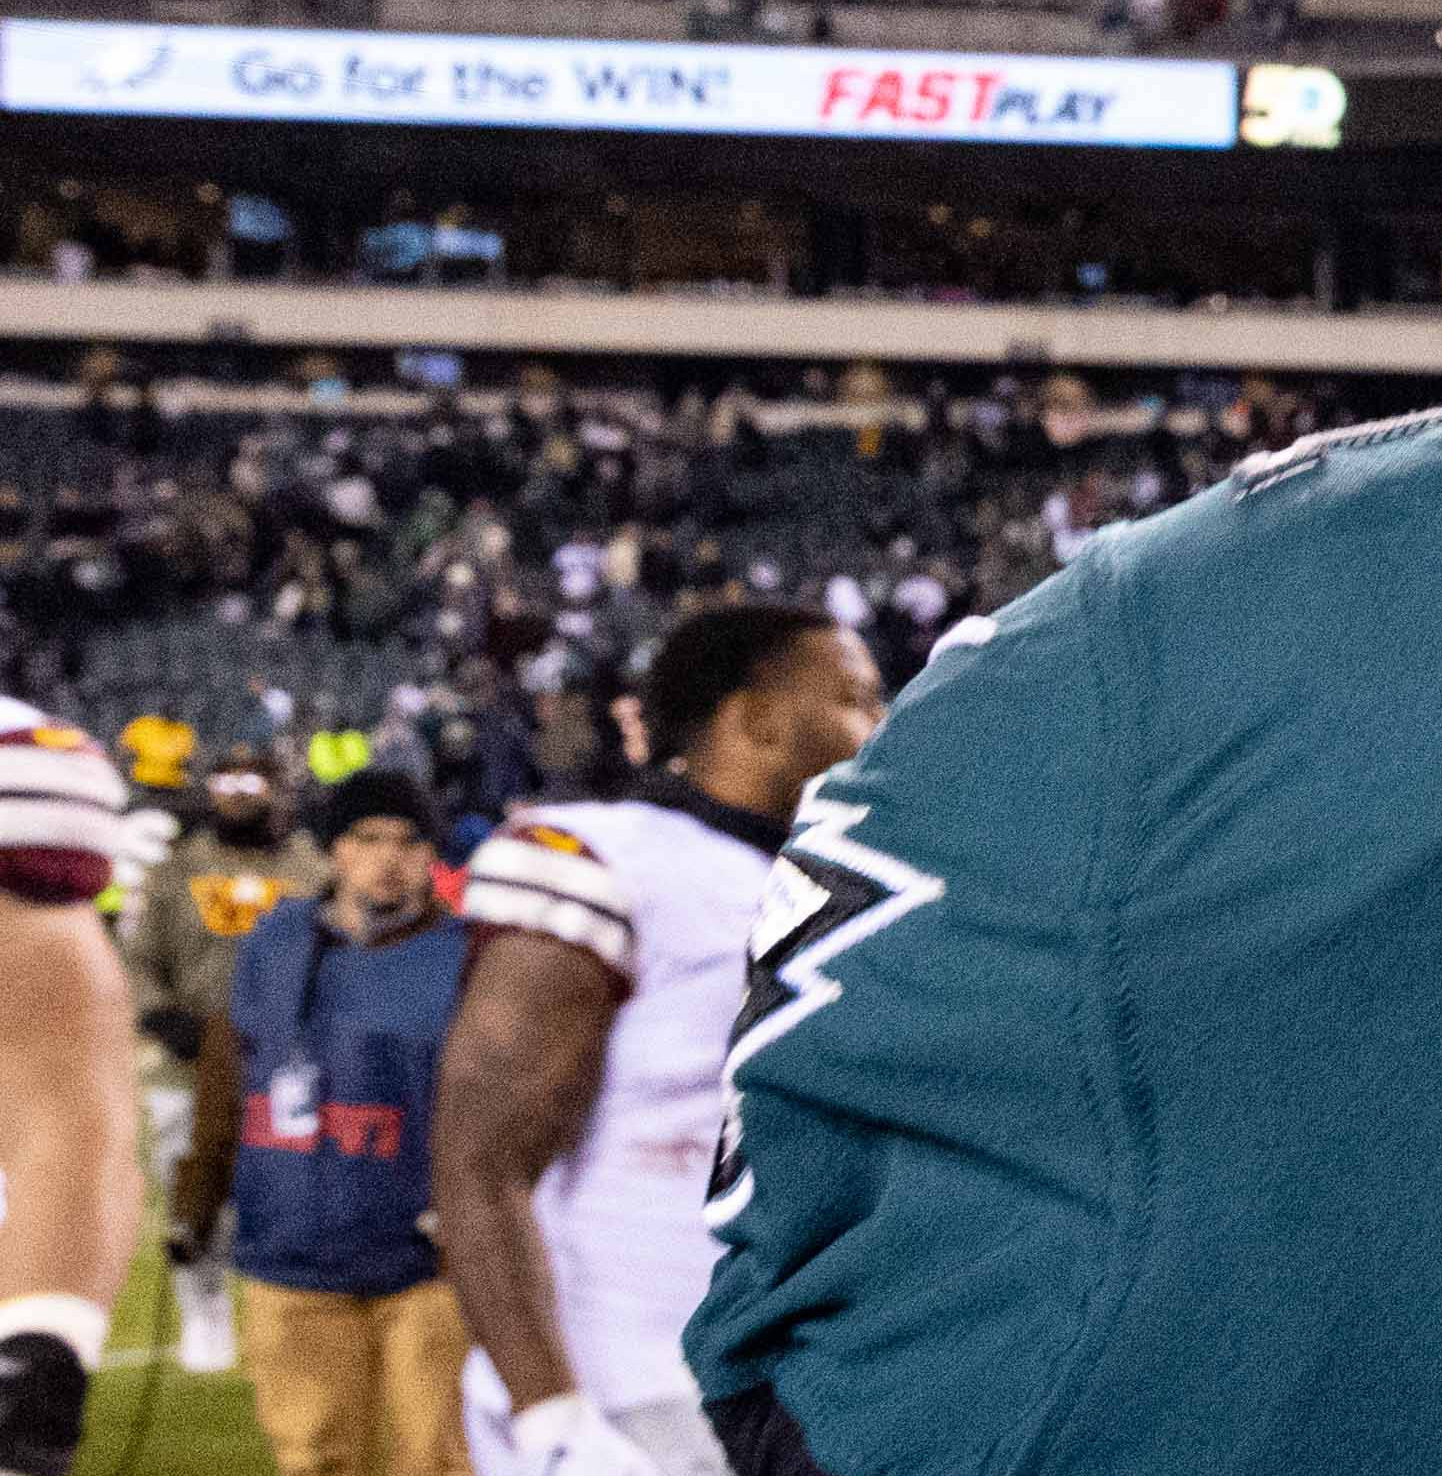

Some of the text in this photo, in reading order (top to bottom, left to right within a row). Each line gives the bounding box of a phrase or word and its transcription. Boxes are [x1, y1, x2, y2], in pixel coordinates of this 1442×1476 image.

[229, 47, 322, 96] Go
[340, 48, 425, 96] for
[452, 60, 550, 101] the
